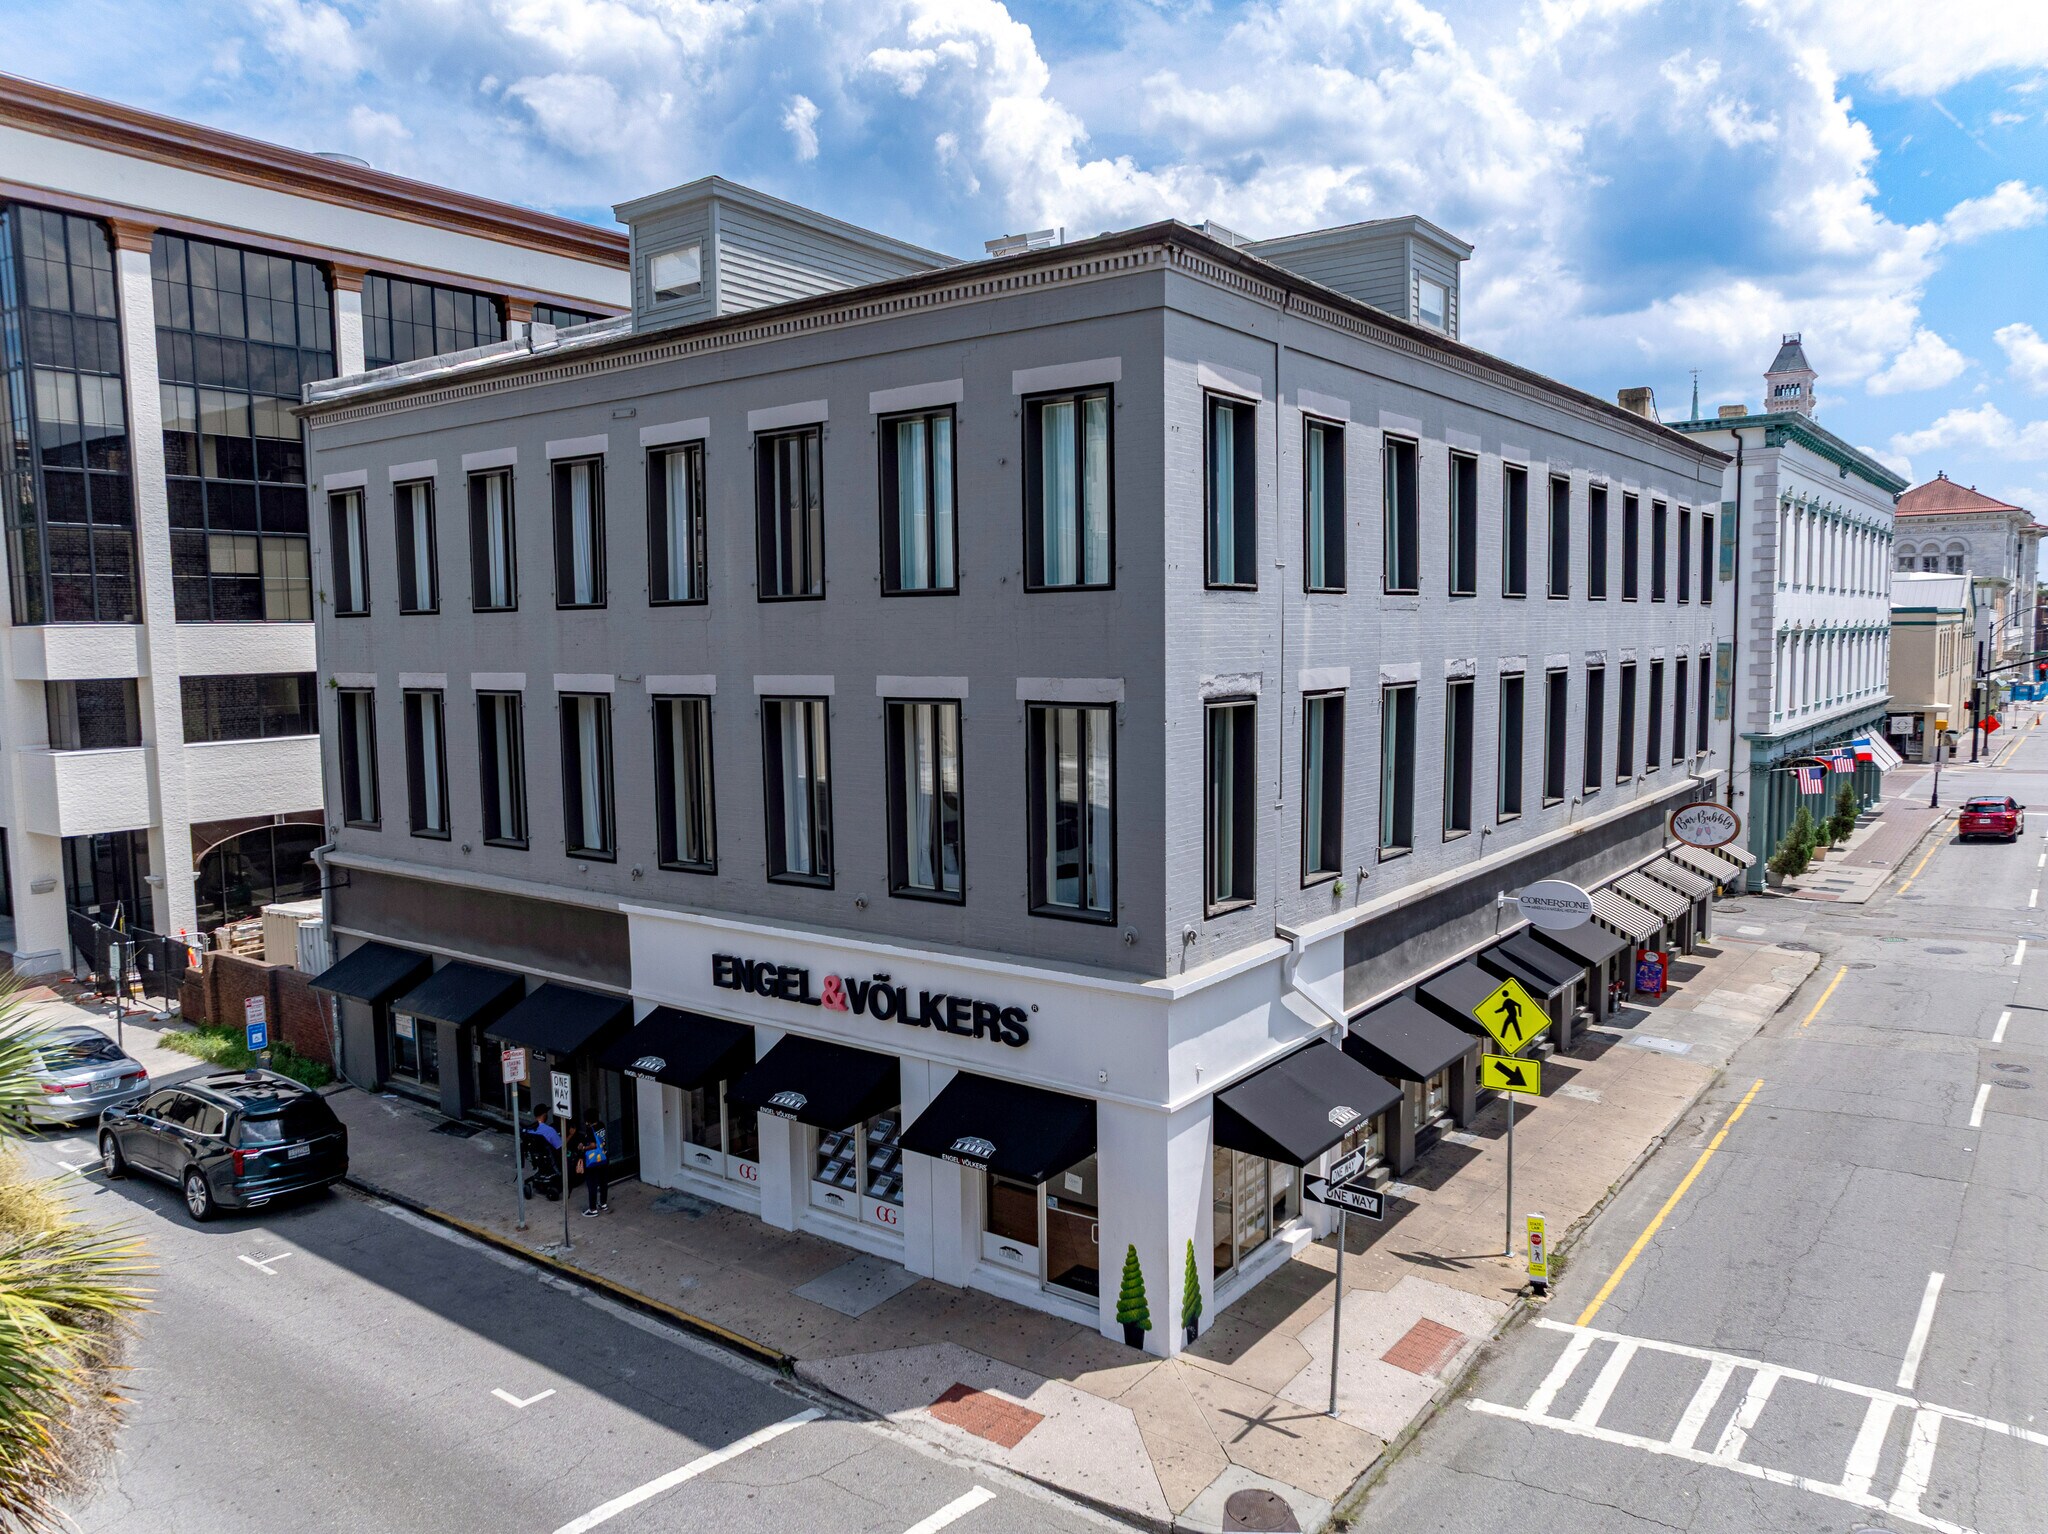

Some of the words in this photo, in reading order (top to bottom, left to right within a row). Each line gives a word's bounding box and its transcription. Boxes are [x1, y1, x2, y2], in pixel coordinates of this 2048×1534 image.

[1675, 815, 1695, 830] Bar
[1697, 810, 1734, 829] Bubbly
[1520, 896, 1589, 909] CORNERSTONE
[553, 1076, 568, 1088] ONE
[554, 1088, 568, 1099] WAY
[1333, 1165, 1343, 1182] ONE
[1344, 1160, 1354, 1175] WAY
[1326, 1188, 1348, 1202] ONE
[1351, 1193, 1375, 1209] WAY
